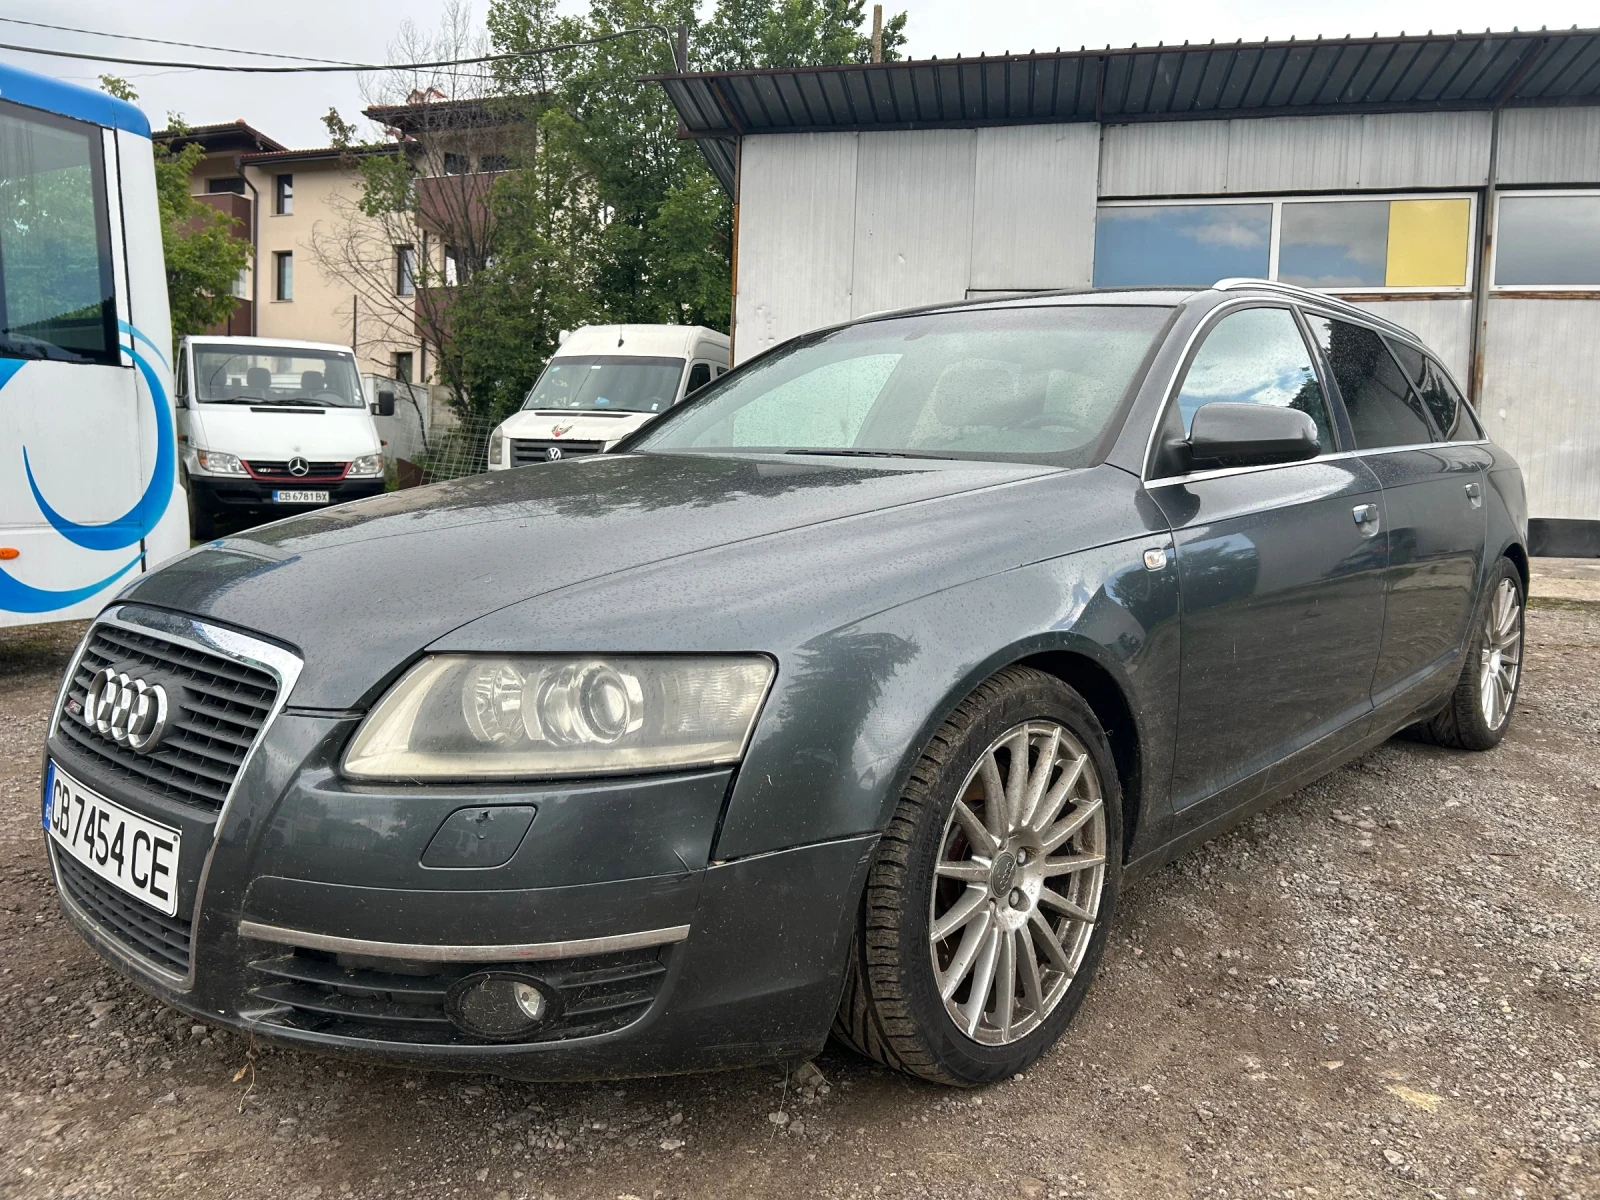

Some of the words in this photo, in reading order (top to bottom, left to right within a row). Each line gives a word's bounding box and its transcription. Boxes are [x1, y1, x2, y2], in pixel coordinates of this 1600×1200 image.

[52, 778, 71, 838] CB
[72, 795, 125, 877] 7454
[131, 829, 173, 901] CE
